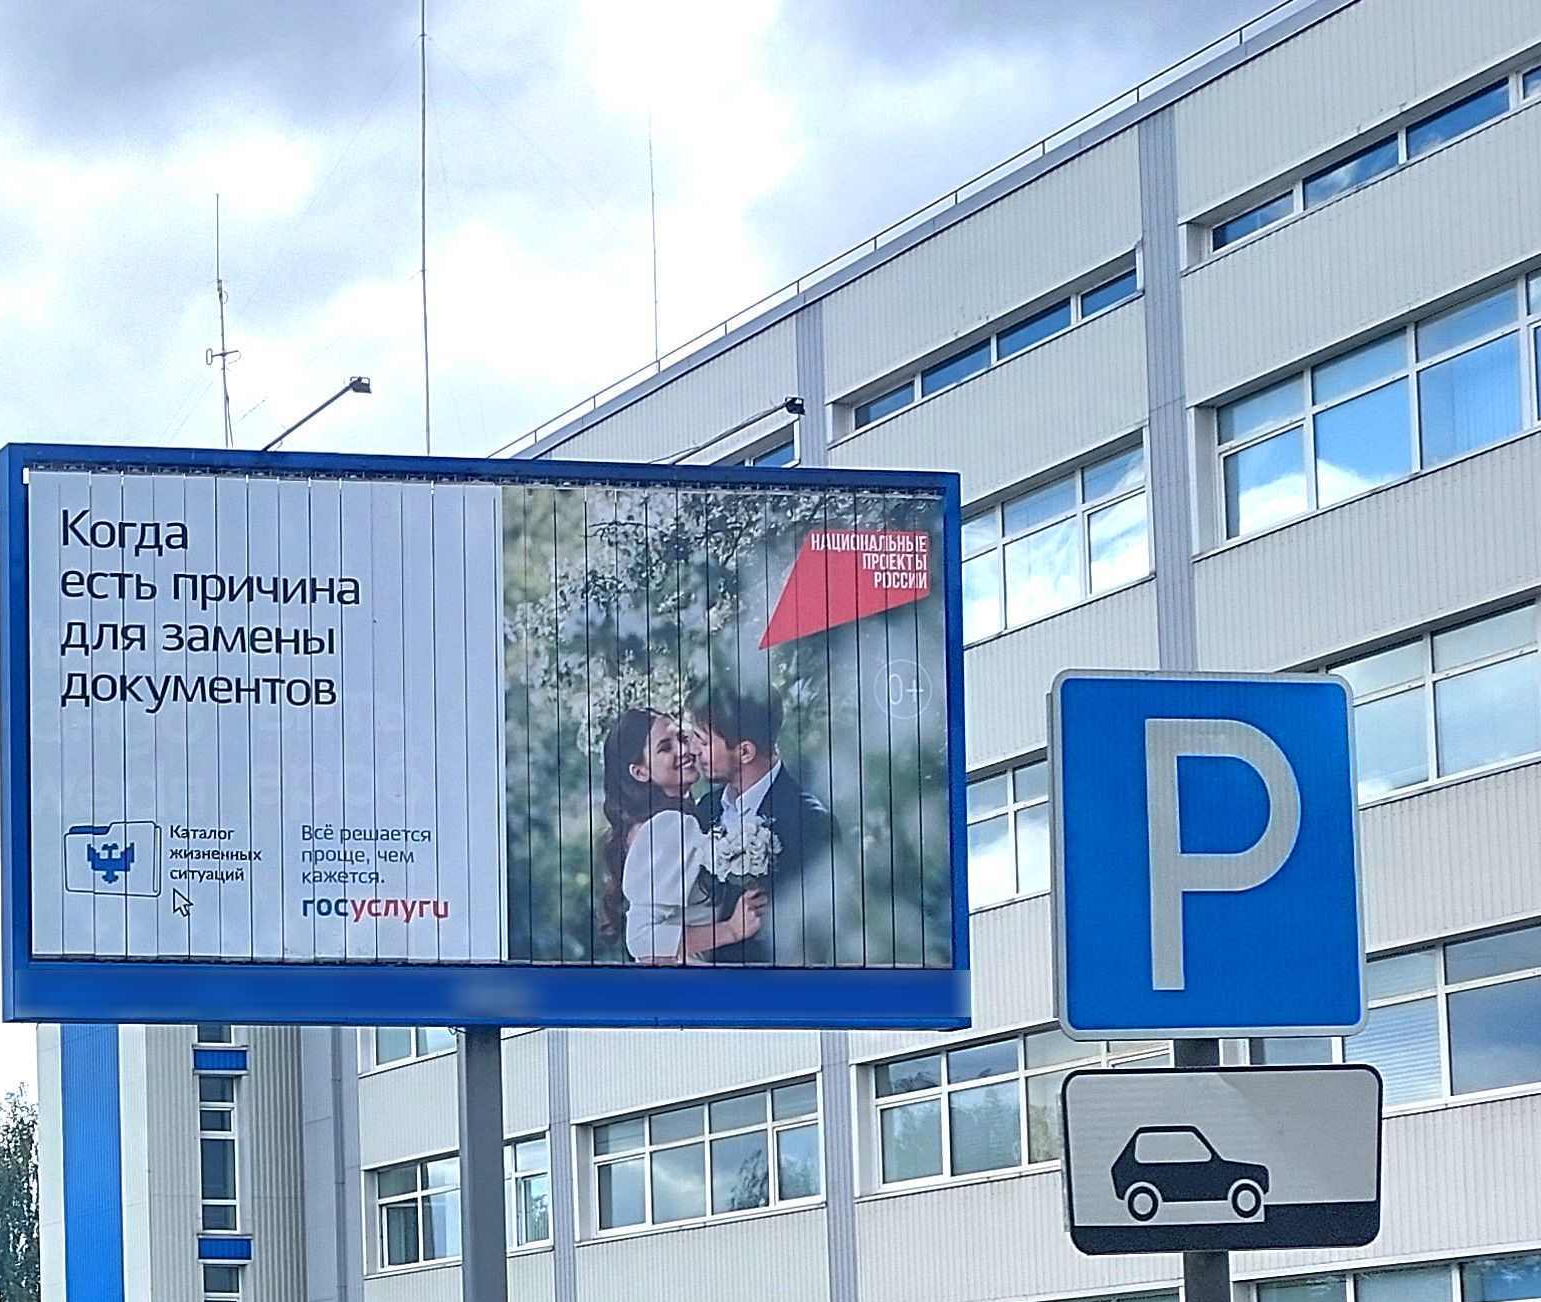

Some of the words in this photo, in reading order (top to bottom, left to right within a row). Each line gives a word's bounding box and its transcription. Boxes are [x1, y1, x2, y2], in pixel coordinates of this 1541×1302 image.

[61, 509, 189, 557] Когда
[810, 533, 928, 553] НАЦИОНАЛЬНЫЕ
[862, 552, 928, 571] ПРОЕКТЫ
[60, 568, 158, 600] есть
[172, 573, 361, 611] причина
[873, 571, 928, 590] РОССИИ
[60, 621, 147, 656] для
[162, 623, 335, 655] замены
[60, 671, 338, 714] документов
[169, 824, 235, 841] Каталог
[301, 824, 335, 842] Всё
[340, 827, 432, 844] решается
[169, 849, 263, 863] жизненных
[301, 850, 371, 866] проще,
[376, 850, 415, 864] чем
[1145, 718, 1301, 991] P
[169, 866, 245, 884] ситуаций
[301, 871, 386, 886] кажется.
[301, 897, 450, 924] госуслуги
